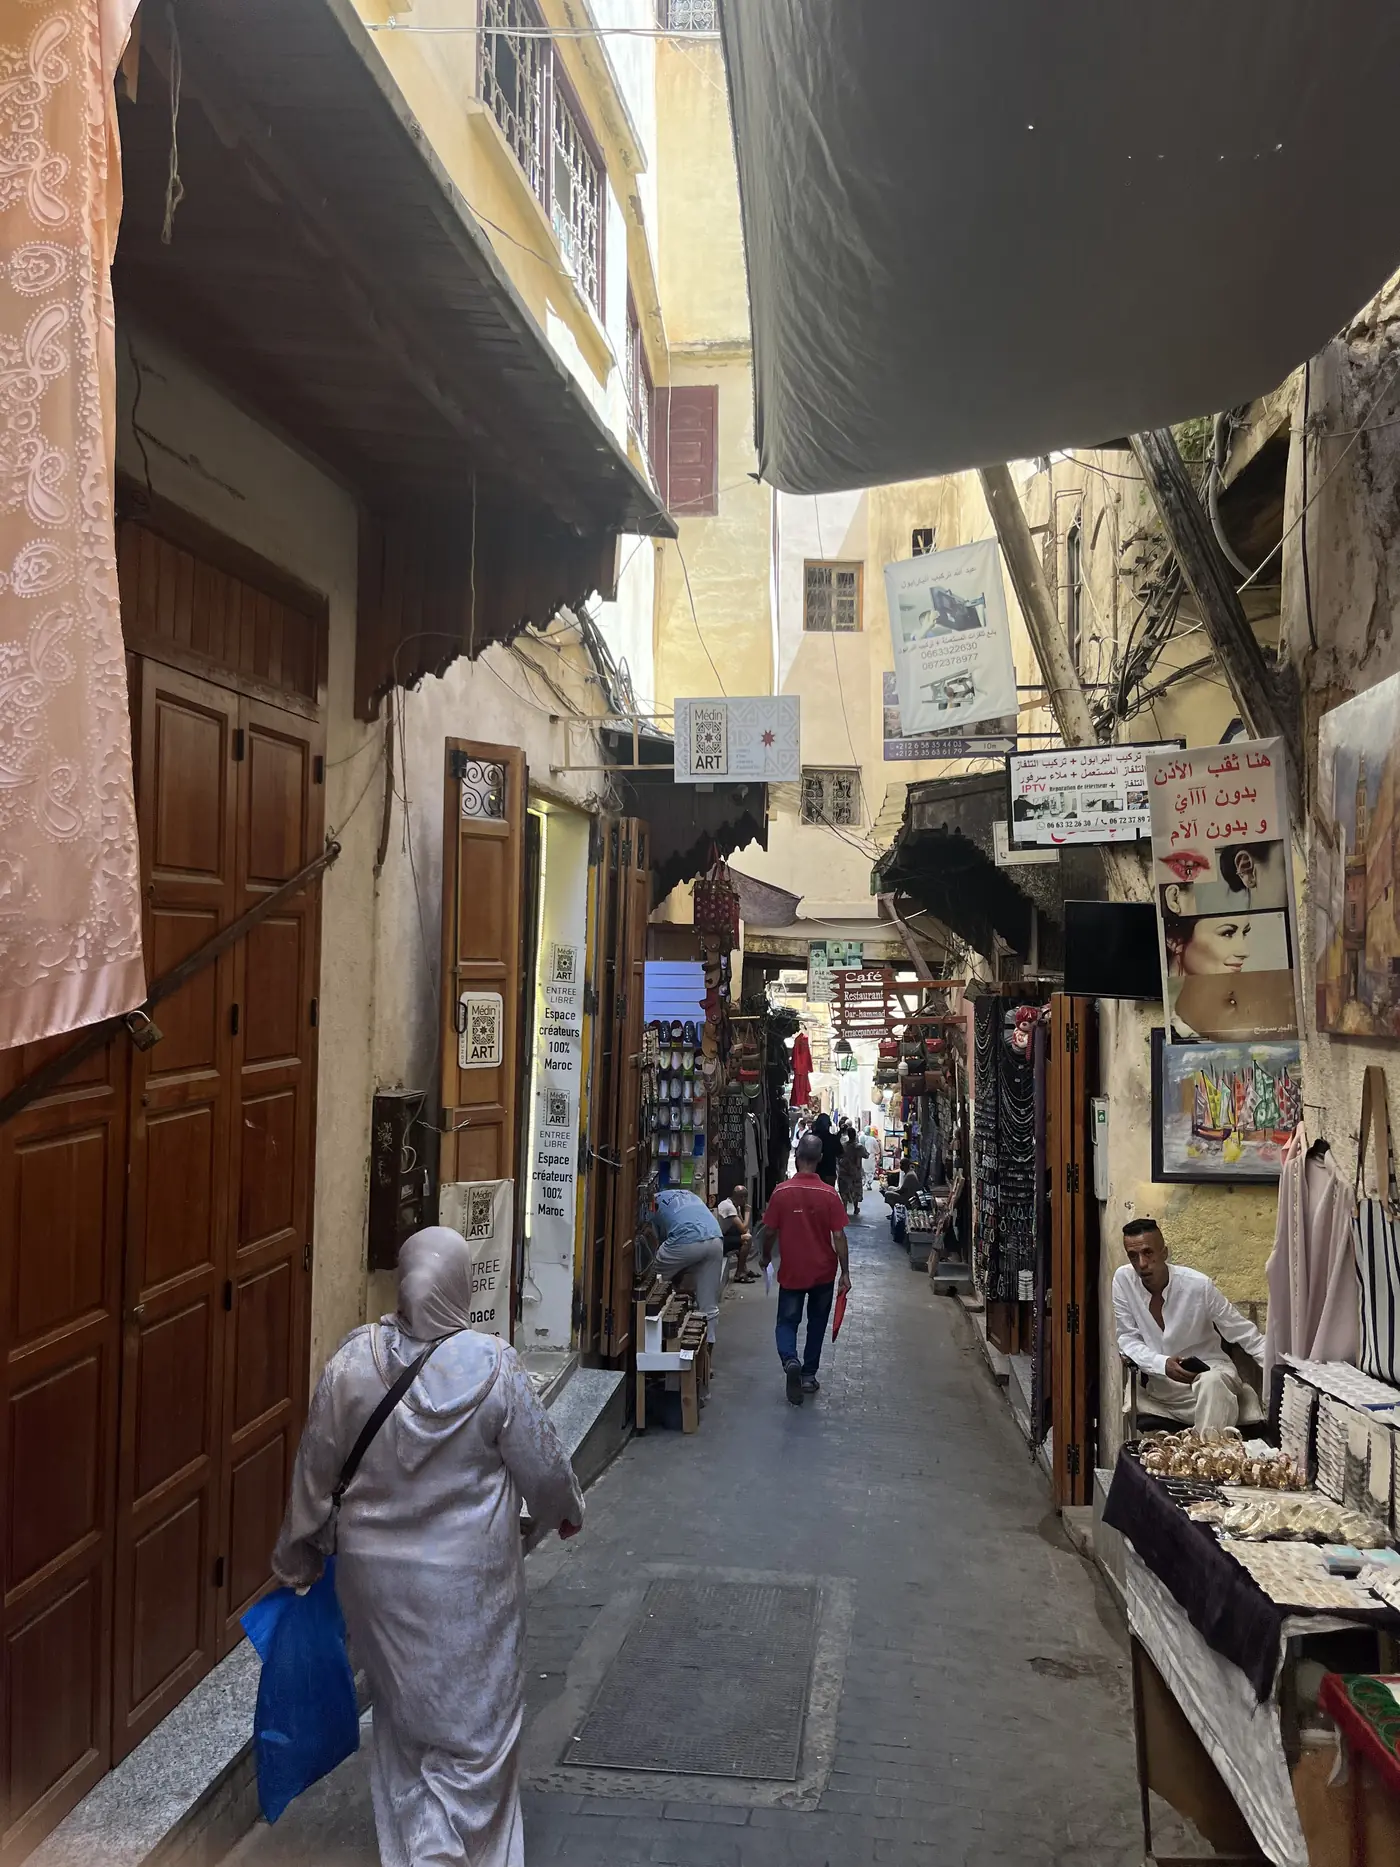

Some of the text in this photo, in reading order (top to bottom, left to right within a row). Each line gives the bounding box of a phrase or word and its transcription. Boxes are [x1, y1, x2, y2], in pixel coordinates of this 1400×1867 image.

[921, 642, 978, 660] 0663322630
[953, 740, 962, 748] 03
[931, 748, 940, 756] 63
[1115, 751, 1142, 763] تركيب
[695, 755, 722, 770] ART
[1015, 759, 1039, 772] التلفاز
[1041, 757, 1068, 769] تركيب
[1080, 753, 1113, 767] البرابول
[1070, 771, 1078, 779] +
[1080, 766, 1119, 780] المستعمل
[1154, 752, 1271, 786] هنا ثقب الأذن
[1021, 783, 1046, 794] IPTV
[1123, 778, 1146, 790] التلفاز
[1215, 786, 1257, 807] بدون
[1046, 821, 1055, 829] 06
[1206, 819, 1248, 839] بدون
[1255, 819, 1267, 834] و
[555, 971, 573, 980] ART
[845, 971, 883, 982] Café
[546, 986, 577, 996] ENTREE
[843, 990, 884, 1001] Restaurant
[550, 996, 574, 1005] LIBRE
[545, 1007, 576, 1022] Espace
[539, 1024, 580, 1038] créateurs
[470, 1045, 495, 1059] ART
[548, 1041, 570, 1054] 100%
[544, 1057, 573, 1071] Maroc
[549, 1115, 566, 1124] ART
[539, 1130, 571, 1140] ENTREE
[543, 1140, 568, 1149] LIBRE
[538, 1151, 570, 1167] Espace
[532, 1169, 573, 1183] créateurs
[542, 1186, 563, 1200] 100%
[537, 1203, 565, 1217] Maroc
[469, 1223, 490, 1237] ART
[471, 1258, 501, 1277] TREE
[471, 1276, 496, 1293] BRE
[470, 1308, 496, 1324] pace
